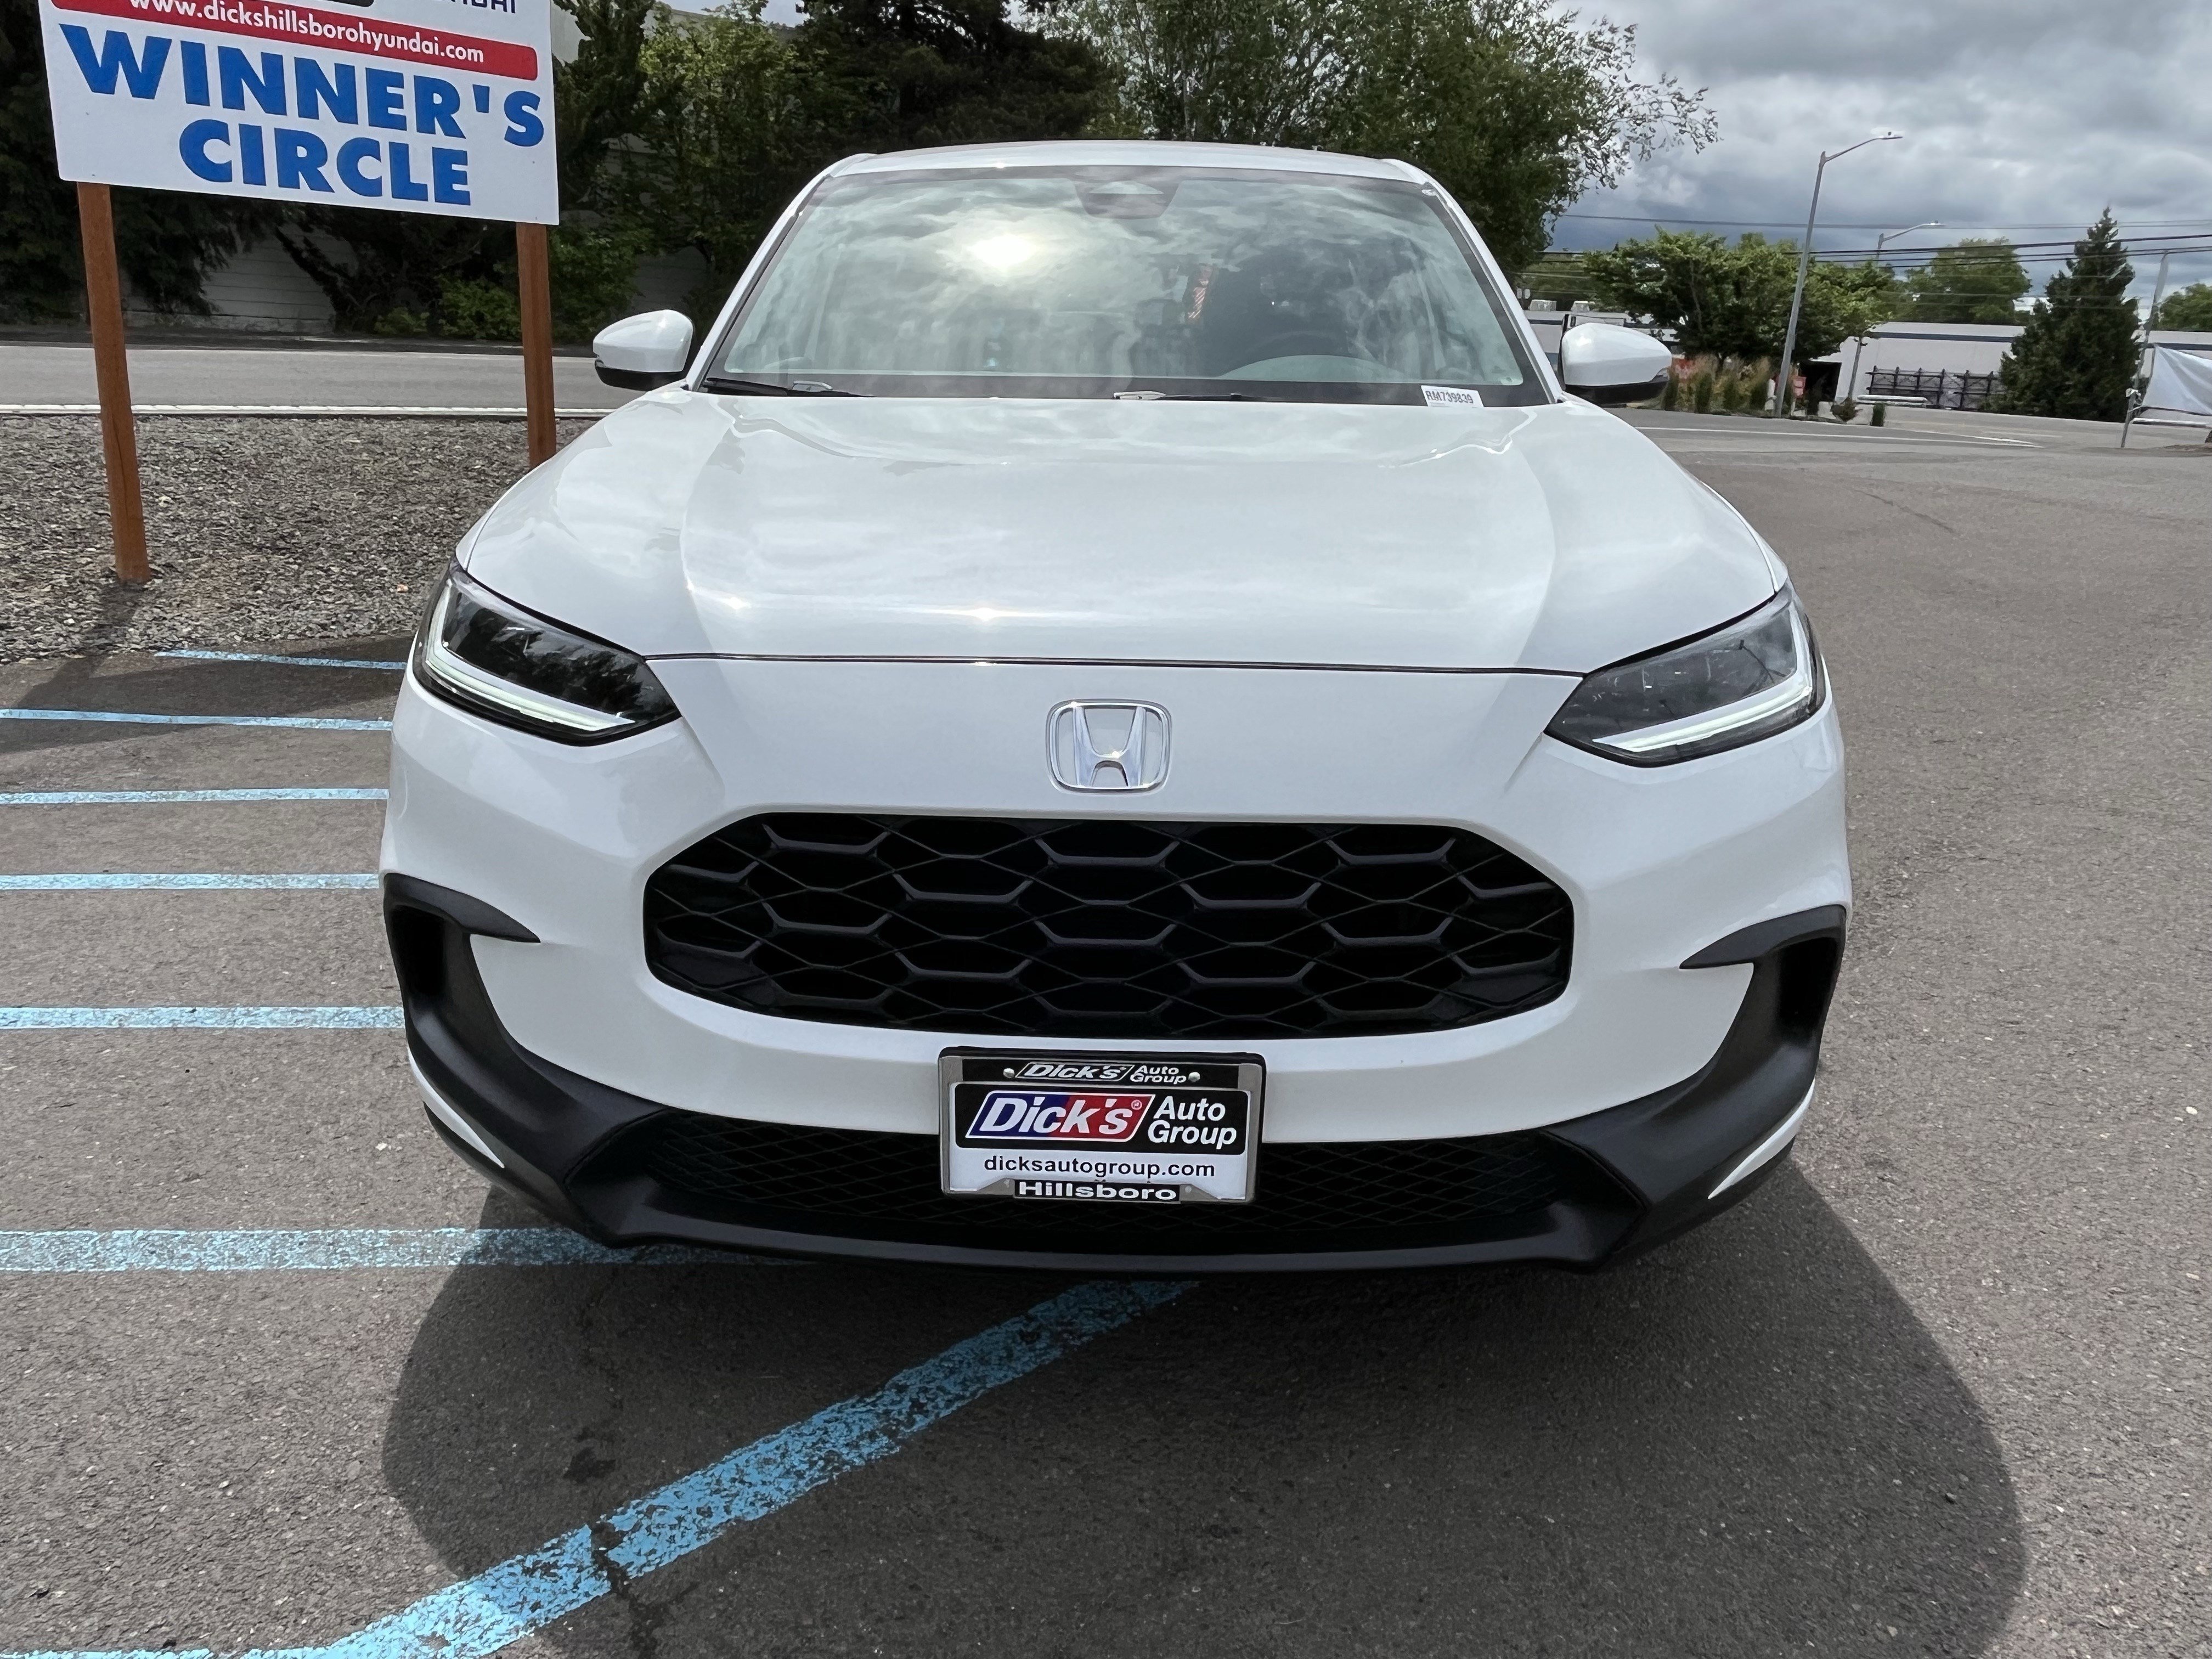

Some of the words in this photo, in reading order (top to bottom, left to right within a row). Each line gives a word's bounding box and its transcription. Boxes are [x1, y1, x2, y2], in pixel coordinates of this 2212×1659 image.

[59, 24, 544, 146] WINNER'S
[179, 119, 471, 206] CIRCLE
[1130, 1072, 1187, 1085] Group
[1135, 1065, 1179, 1075] Auto
[1154, 1096, 1226, 1121] Auto
[1148, 1120, 1237, 1150] Group
[984, 1156, 1215, 1178] dicksautogroup.com
[1019, 1181, 1177, 1200] Hillsboro
